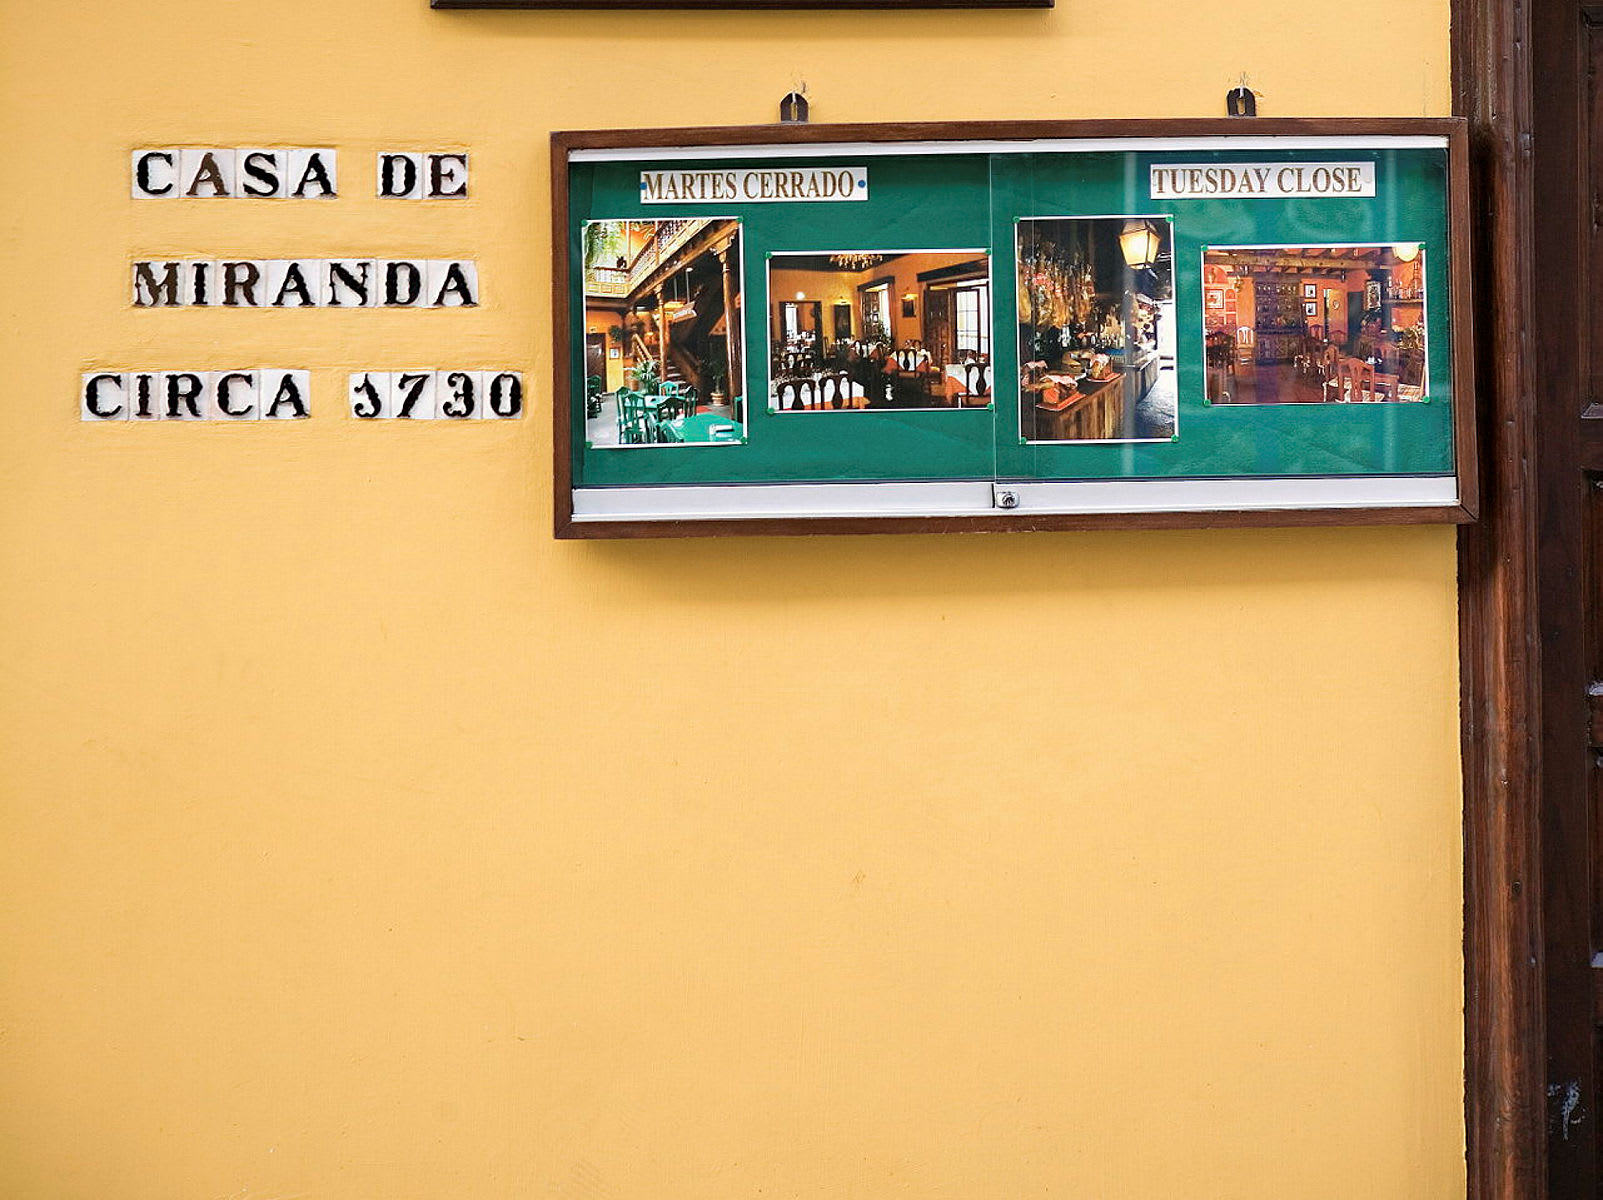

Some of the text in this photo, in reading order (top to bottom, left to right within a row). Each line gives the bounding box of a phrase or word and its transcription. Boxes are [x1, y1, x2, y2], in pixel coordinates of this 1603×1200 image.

[136, 152, 467, 196] CASA DE
[642, 170, 855, 201] MARTES CERRADO
[1152, 166, 1362, 195] TUESDAY CLOSE
[133, 262, 478, 306] MIRANDA
[85, 373, 523, 419] CIRCA 1730
